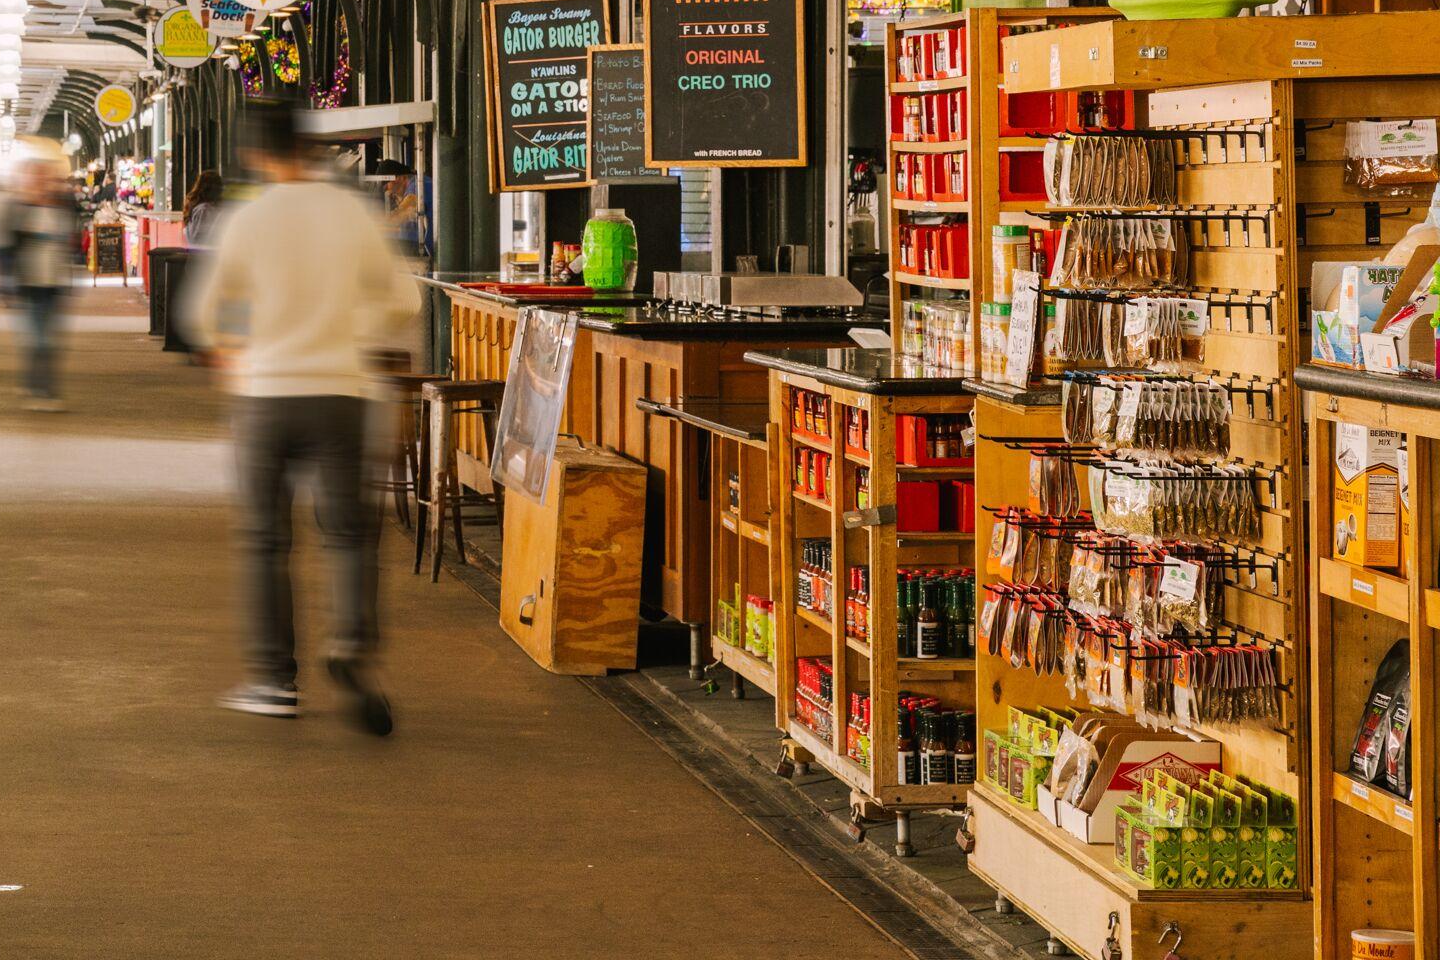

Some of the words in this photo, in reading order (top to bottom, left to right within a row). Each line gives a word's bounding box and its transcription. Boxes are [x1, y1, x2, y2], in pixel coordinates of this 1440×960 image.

[212, 10, 245, 22] Dock
[549, 7, 591, 21] Swamp
[683, 23, 767, 35] FLAVORS
[504, 25, 545, 55] GATOR
[549, 20, 600, 48] BURGER
[685, 49, 765, 65] ORIGINAL
[677, 74, 725, 91] CREO
[732, 73, 772, 90] TRIO
[511, 102, 532, 117] ON
[538, 102, 548, 114] A
[513, 145, 559, 173] GATOR
[693, 149, 708, 157] with
[709, 149, 737, 157] FRENCH
[738, 149, 763, 157] BREAD
[1369, 429, 1399, 438] BEIGNET
[1378, 438, 1391, 446] MIX
[1369, 943, 1394, 957] Monde
